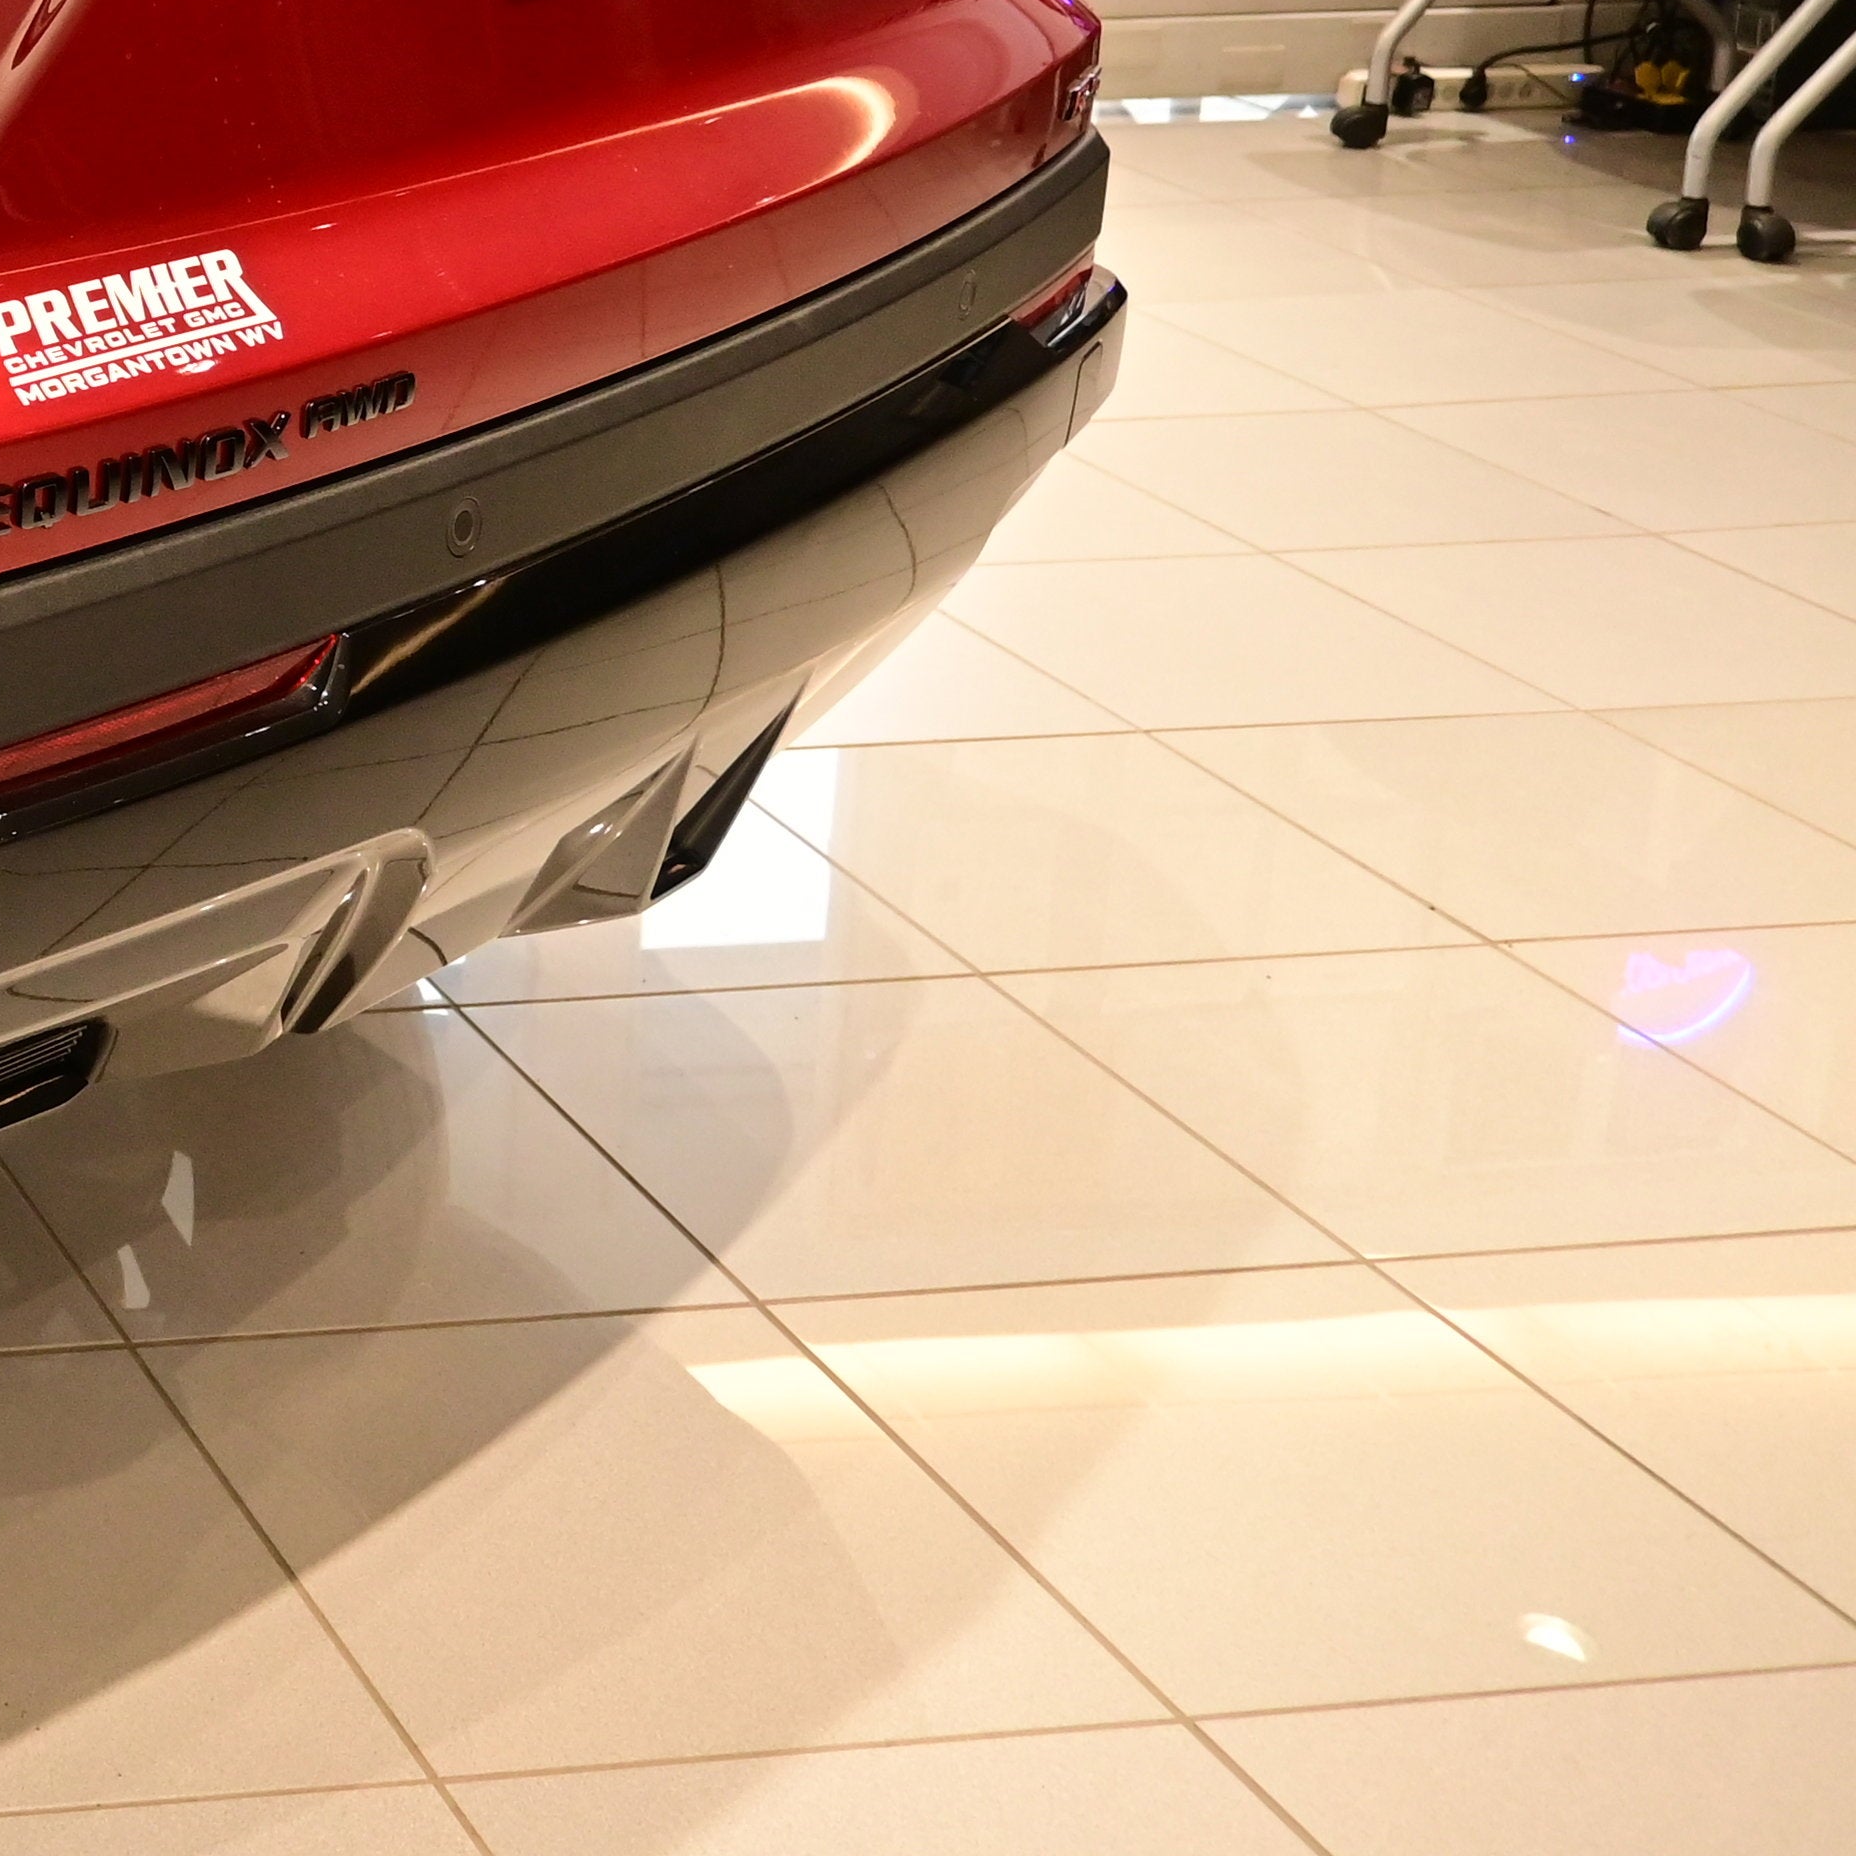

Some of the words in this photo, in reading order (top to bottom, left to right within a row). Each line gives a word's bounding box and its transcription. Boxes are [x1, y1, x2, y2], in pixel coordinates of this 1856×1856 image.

[6, 316, 177, 376] CHEVROLET
[189, 300, 245, 330] GMC
[13, 338, 237, 407] MORGANTOWN
[239, 321, 285, 350] WV
[299, 370, 417, 440] AWD
